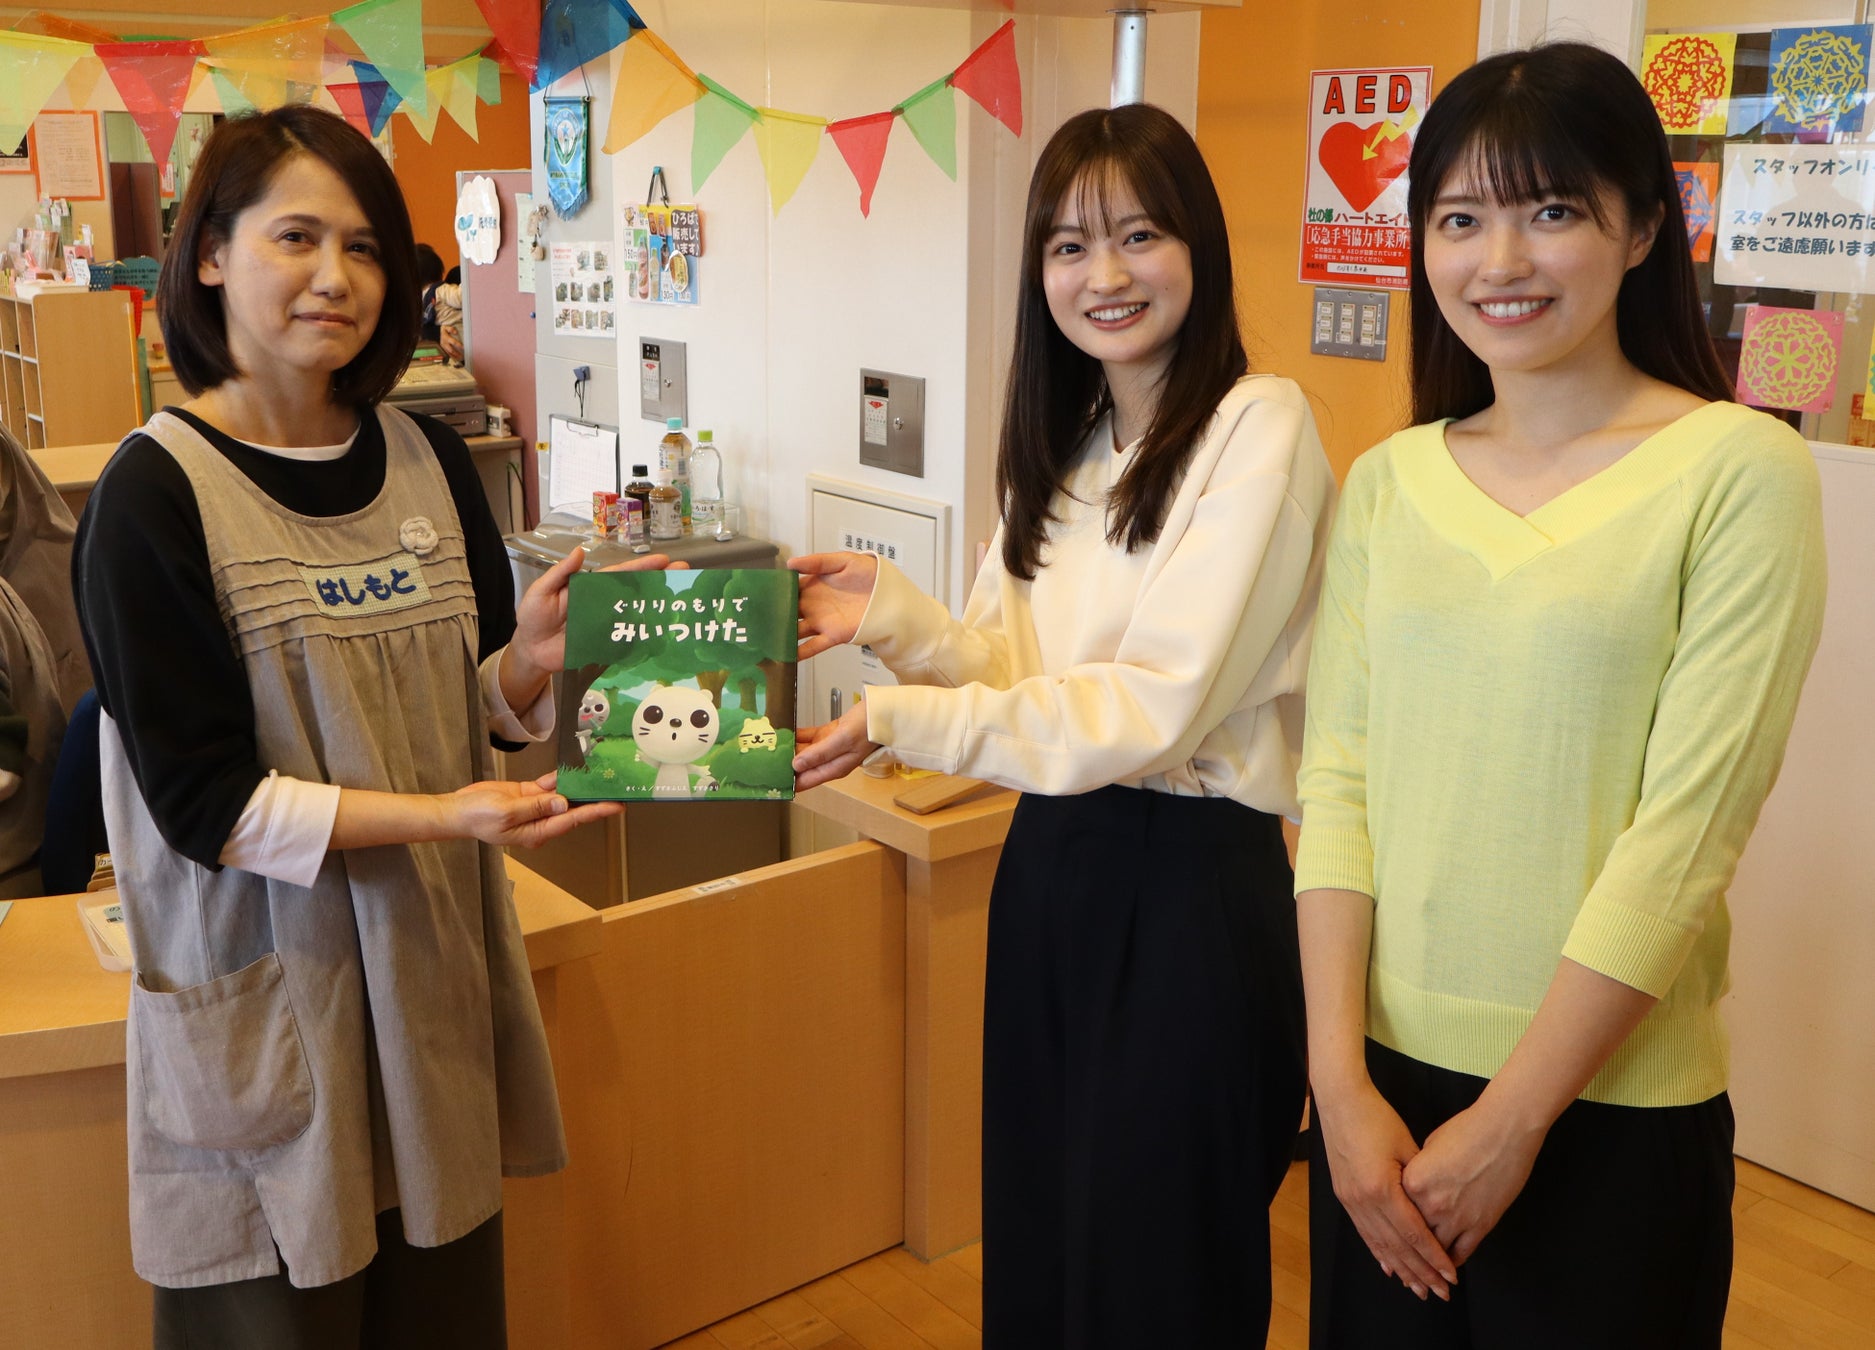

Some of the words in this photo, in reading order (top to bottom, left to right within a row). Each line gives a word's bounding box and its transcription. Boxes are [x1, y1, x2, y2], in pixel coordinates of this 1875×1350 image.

[1323, 74, 1412, 114] AED
[1753, 159, 1875, 175] スタッフオンリ
[316, 569, 416, 606] はしもと
[613, 597, 748, 614] ぐりりのもりで
[610, 618, 748, 643] みいつけた
